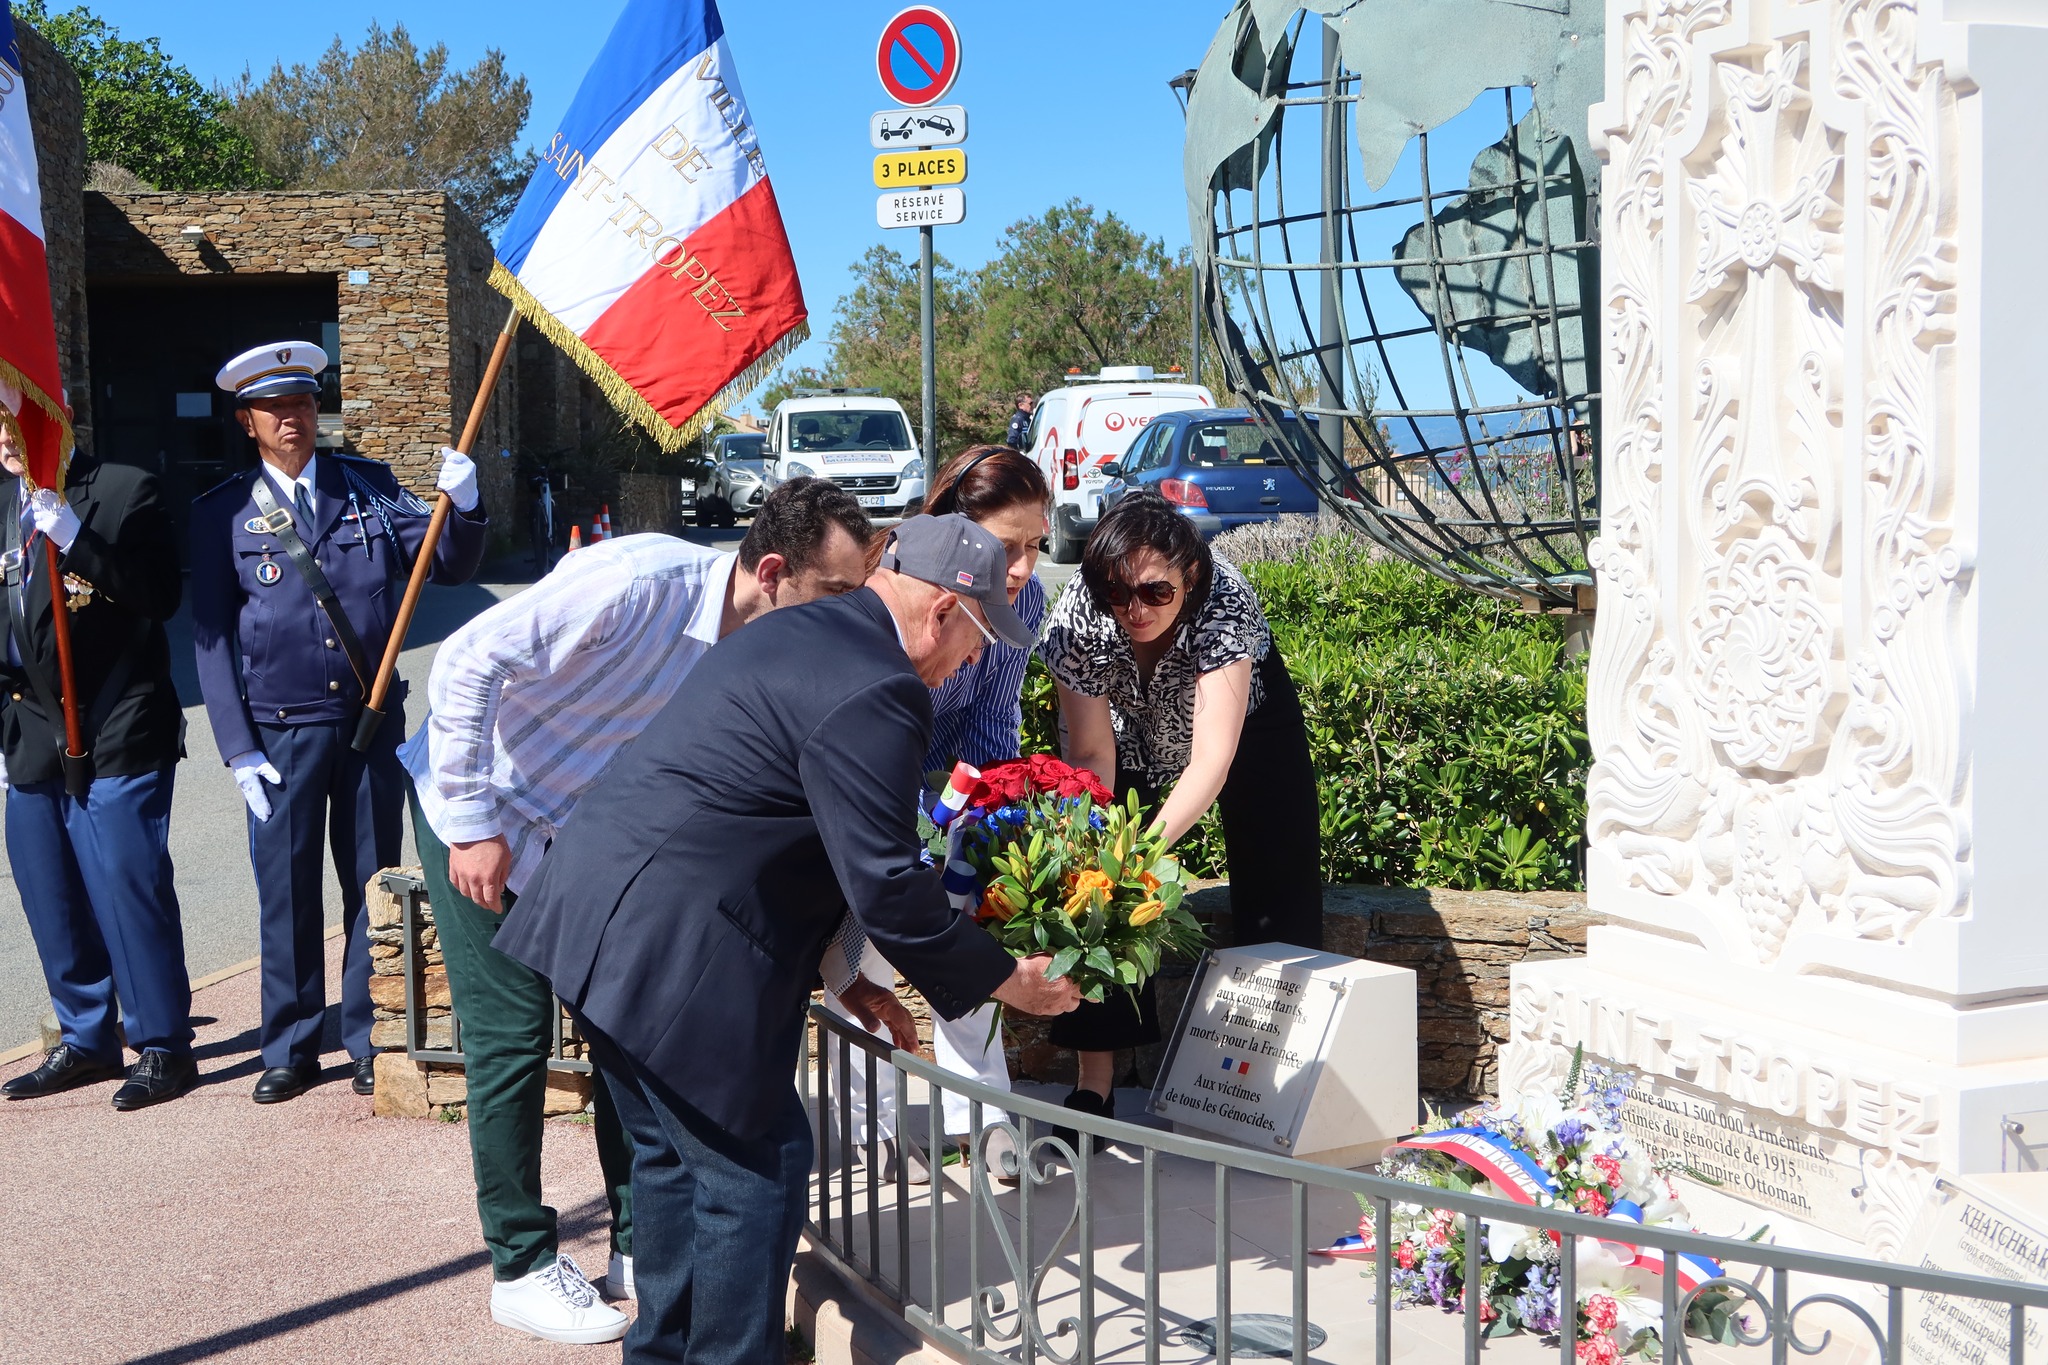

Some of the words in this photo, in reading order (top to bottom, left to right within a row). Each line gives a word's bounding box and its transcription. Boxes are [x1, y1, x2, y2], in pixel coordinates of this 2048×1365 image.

[696, 53, 766, 178] VILLE
[651, 124, 713, 184] DE
[882, 164, 890, 178] 3
[898, 158, 956, 177] PLACES
[894, 193, 945, 208] RÉSERVÉ
[896, 209, 943, 222] SERVICE
[543, 131, 747, 333] SAINT-TROPEZ
[1232, 966, 1247, 981] En
[1248, 970, 1302, 996] hommage
[1216, 988, 1236, 1001] aux
[1237, 993, 1303, 1017] combattants
[1221, 1009, 1281, 1037] Arméniens,
[1189, 1026, 1220, 1043] morts
[1219, 1034, 1248, 1049] pour
[1248, 1037, 1258, 1053] la
[1260, 1040, 1299, 1063] France.
[1514, 980, 1940, 1153] SAINT-TROPEZ
[1193, 1073, 1216, 1091] Aux
[1217, 1081, 1262, 1103] victimes
[1165, 1088, 1178, 1102] de
[1179, 1093, 1202, 1110] tous
[1202, 1097, 1217, 1114] les
[1219, 1103, 1276, 1132] Génocides.
[1618, 1108, 1661, 1132] ictimes
[1663, 1120, 1679, 1139] du
[1682, 1127, 1740, 1159] génocide
[1744, 1146, 1760, 1166] de
[1764, 1153, 1802, 1182] 1915,
[1657, 1097, 1681, 1114] aux
[1683, 1102, 1689, 1117] 1
[1693, 1104, 1717, 1126] 500
[1720, 1112, 1743, 1134] 000
[1748, 1122, 1830, 1165] Arméniens,
[1744, 1172, 1811, 1210] Ottoman.
[1920, 1314, 1933, 1332] de
